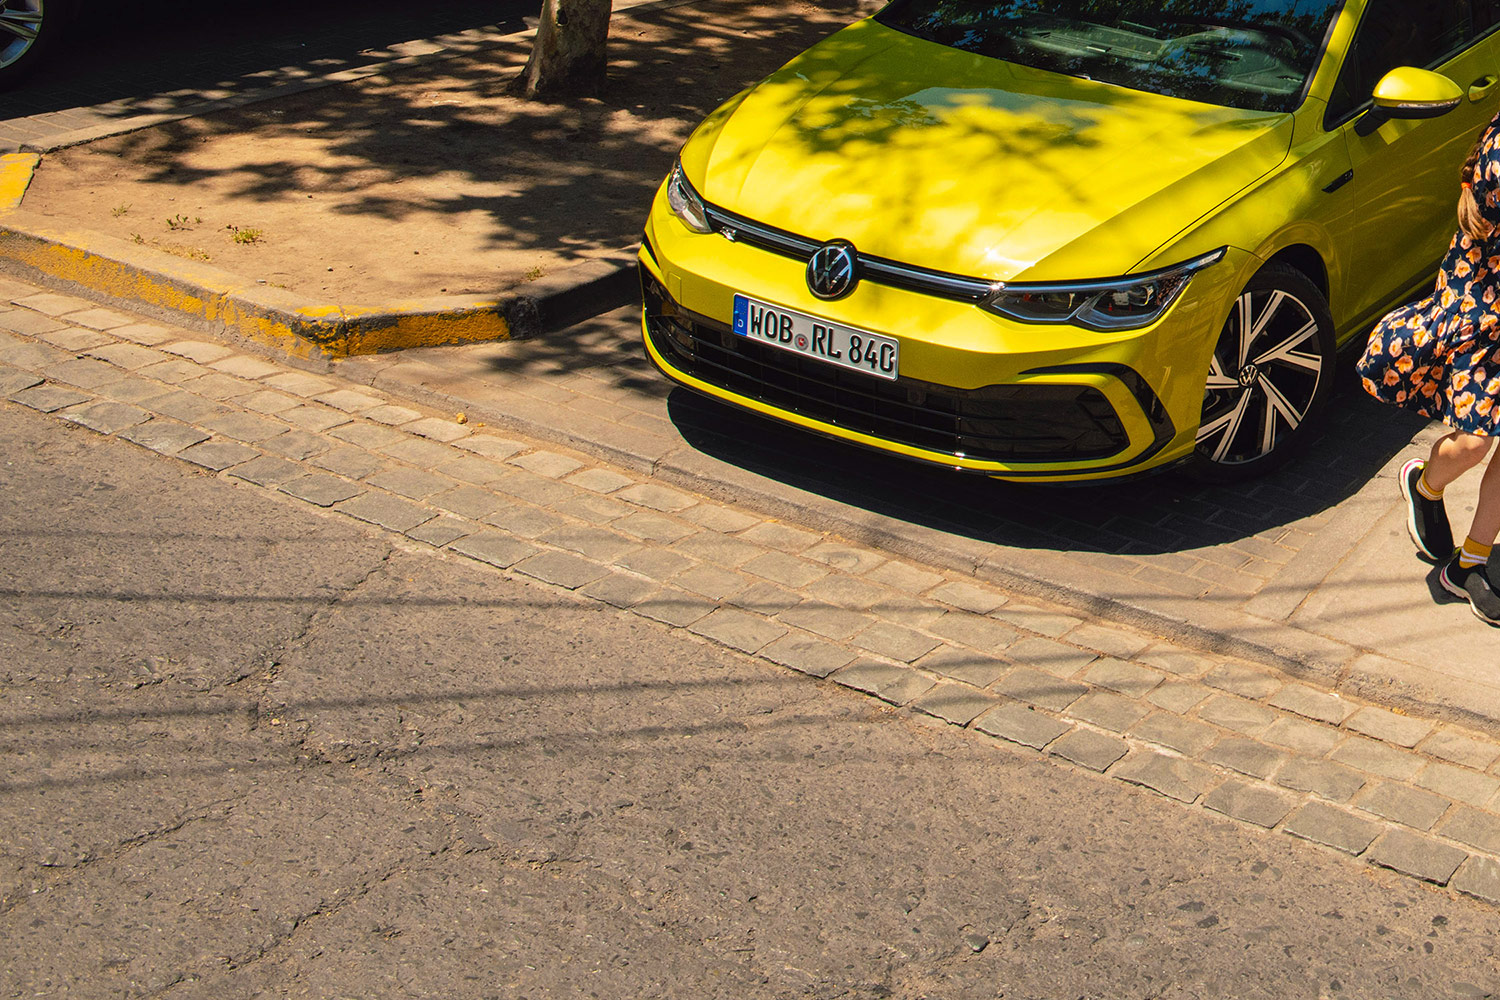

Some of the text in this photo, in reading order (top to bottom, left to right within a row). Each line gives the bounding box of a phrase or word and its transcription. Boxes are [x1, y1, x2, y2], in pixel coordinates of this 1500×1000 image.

[750, 305, 894, 372] WOB RL 840
